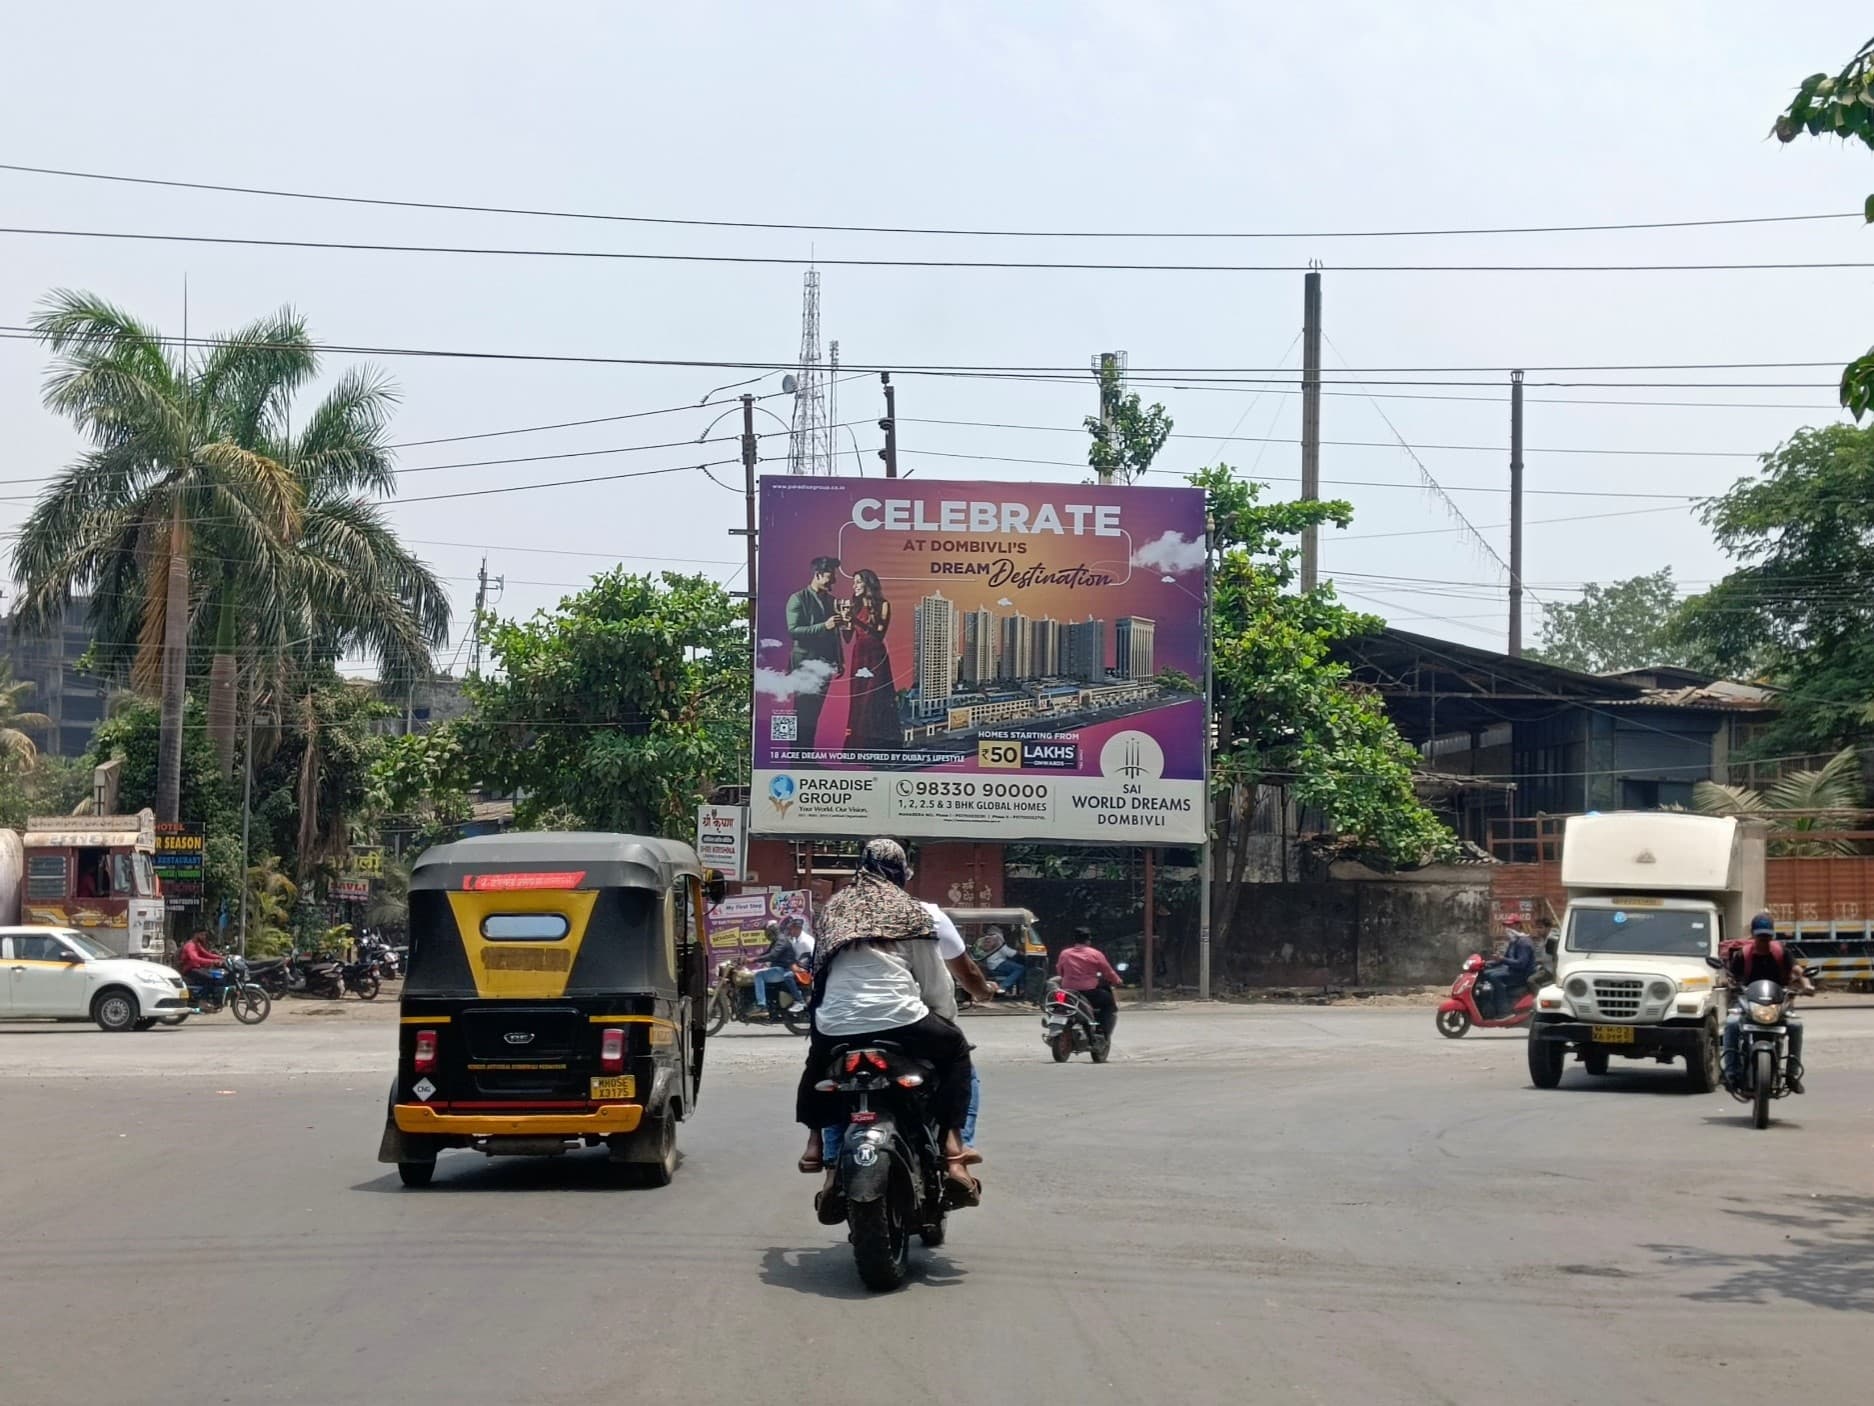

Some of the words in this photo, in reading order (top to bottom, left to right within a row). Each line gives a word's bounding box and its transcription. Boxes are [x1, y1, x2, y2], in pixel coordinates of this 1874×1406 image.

[852, 498, 1121, 537] CELEBRATE
[903, 539, 927, 551] AT
[930, 540, 1027, 554] DOMBIVLI'S
[930, 562, 990, 575] DREAM
[988, 558, 1113, 589] Destination
[978, 731, 1009, 739] HOMES
[1011, 732, 1052, 740] STARTING
[1054, 733, 1080, 741] FROM
[828, 752, 855, 760] WORLD
[857, 753, 889, 761] INSPIRED
[902, 754, 932, 762] DUBAI'S
[932, 754, 965, 763] LIFESTYLE
[799, 778, 873, 791] PARADISE
[916, 782, 976, 797] 98330
[982, 783, 1048, 798] 90000
[1123, 784, 1141, 794] SAI
[799, 792, 852, 804] GROUP
[1072, 795, 1127, 809] WORLD
[1131, 797, 1191, 812] DREAMS
[910, 800, 918, 809] 2,
[920, 801, 935, 809] 2.5
[937, 801, 945, 809] &
[947, 801, 953, 809] 3
[955, 801, 974, 810] BHK
[976, 801, 1012, 811] GLOBAL
[1013, 802, 1047, 811] HOMES
[1097, 814, 1165, 826] DOMBIVLI
[164, 836, 201, 849] SEASON
